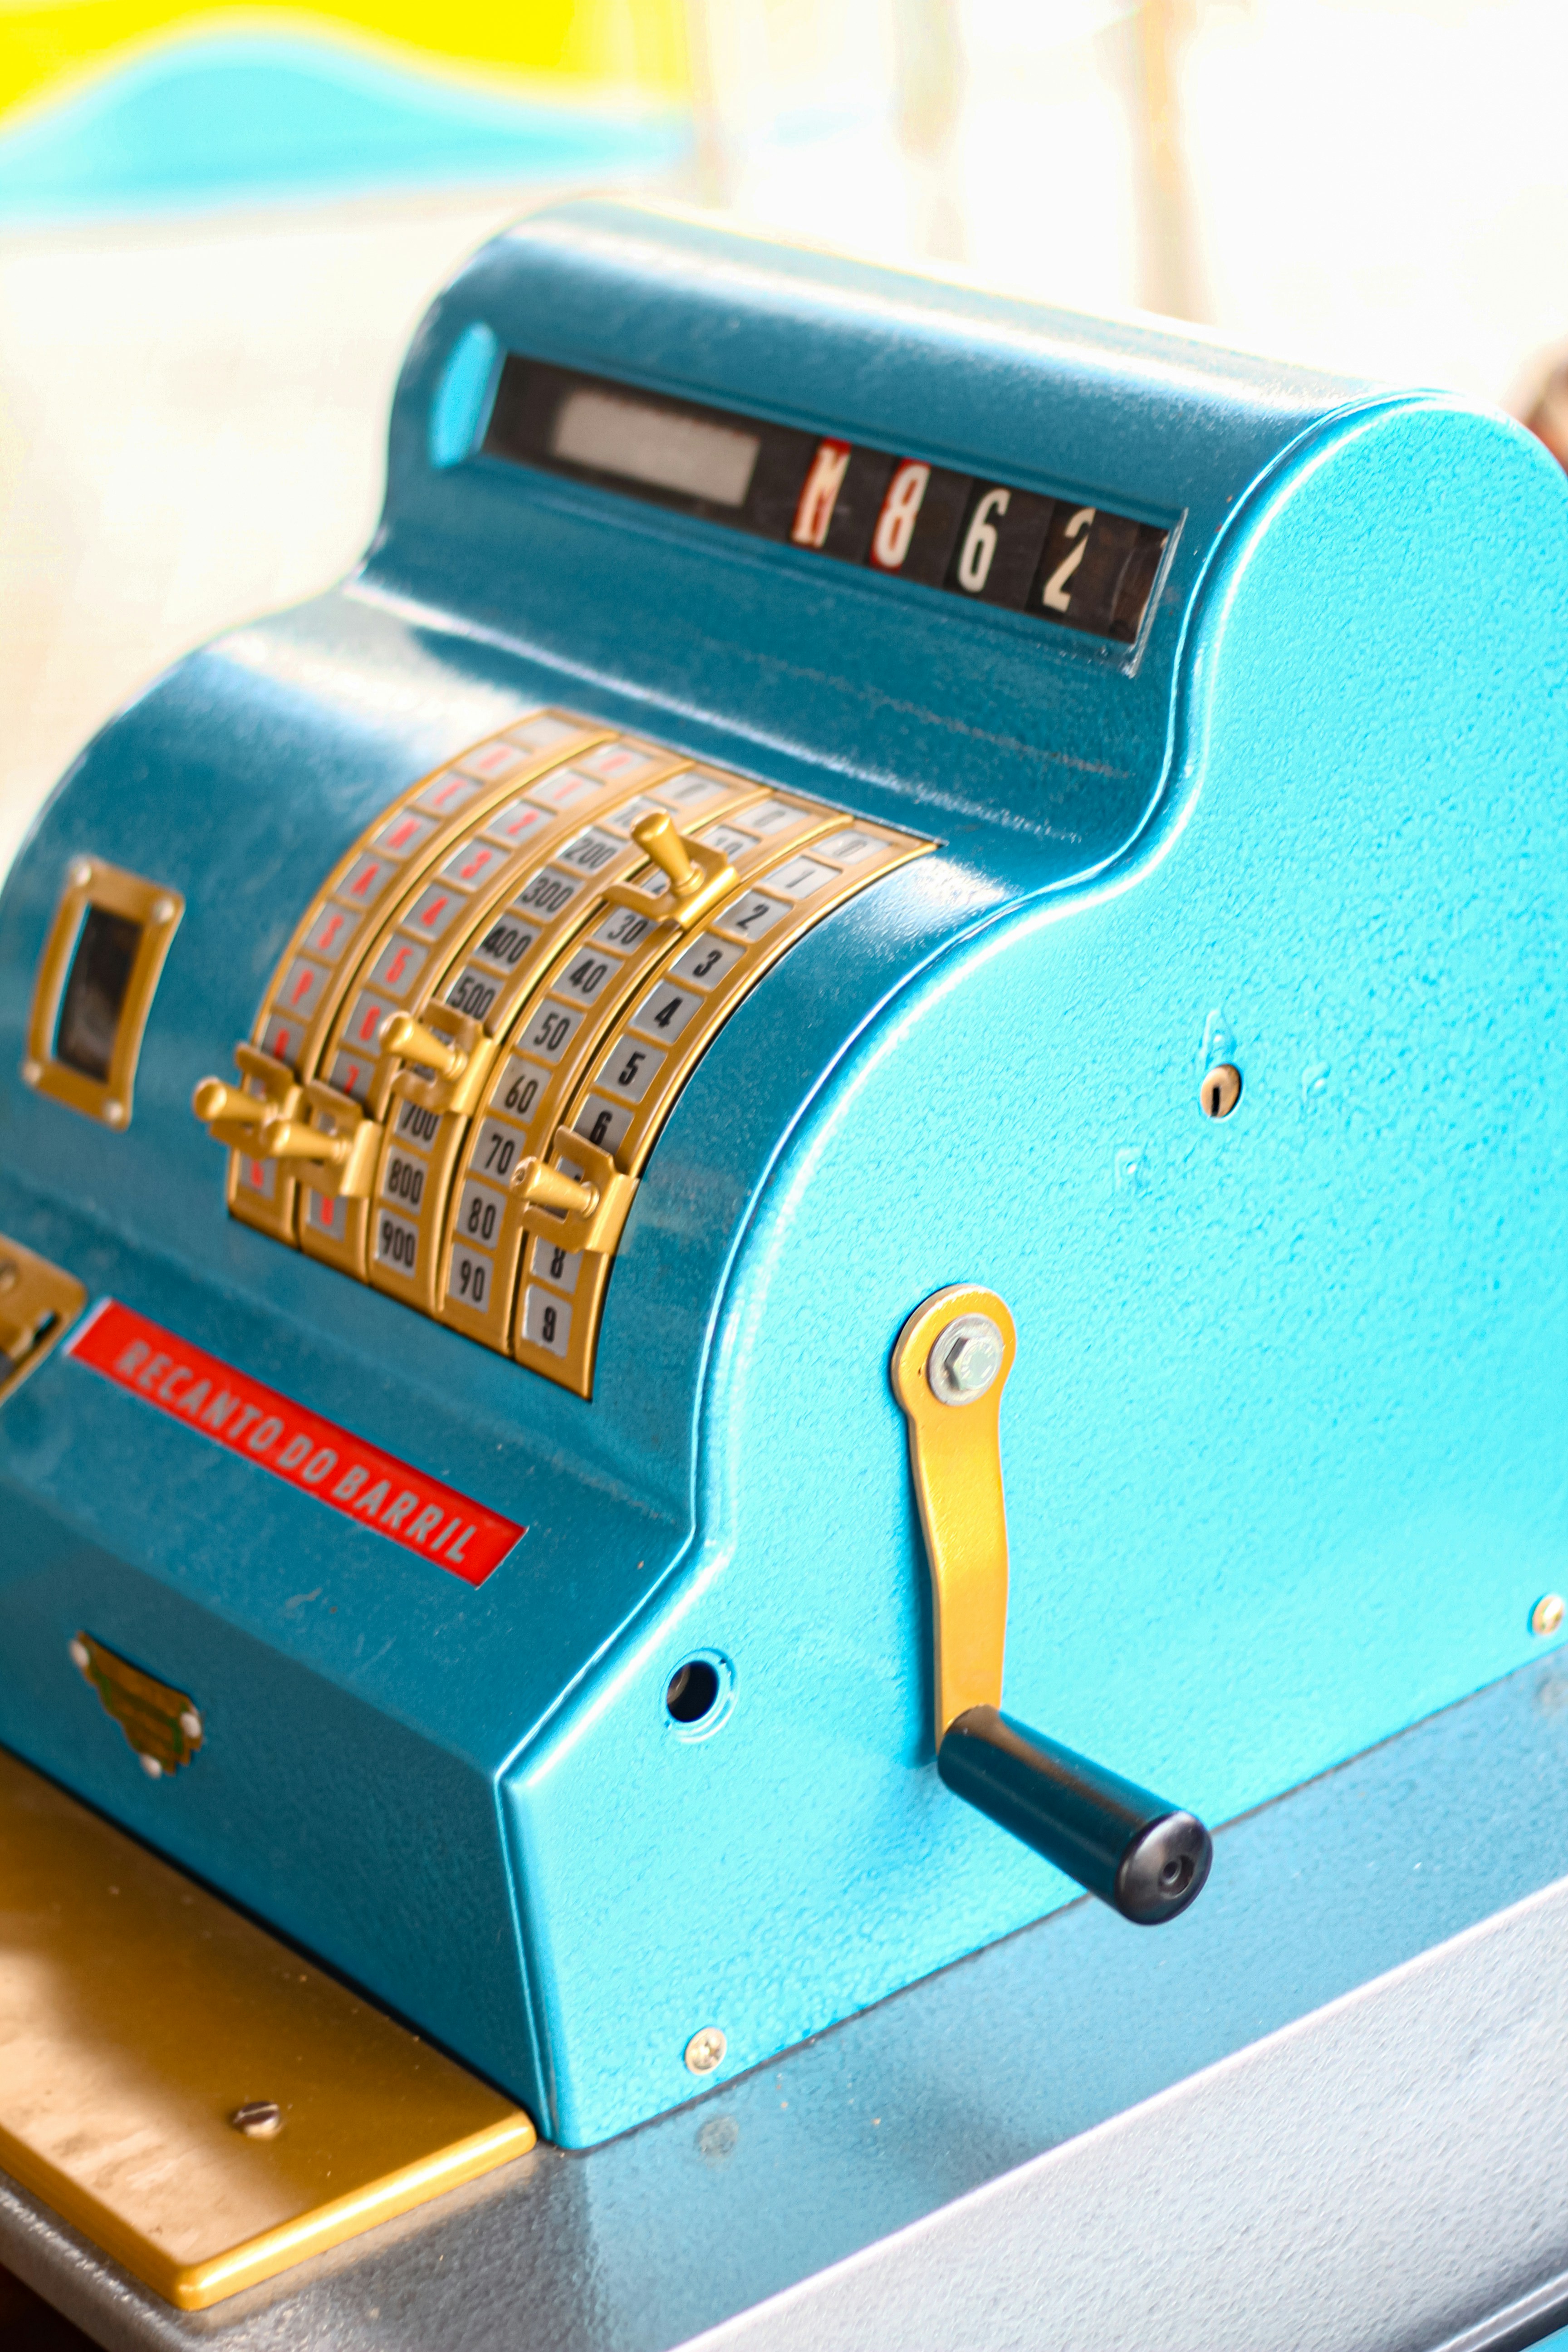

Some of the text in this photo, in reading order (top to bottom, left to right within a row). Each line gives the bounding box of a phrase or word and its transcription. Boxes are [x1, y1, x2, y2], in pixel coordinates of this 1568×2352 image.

[521, 877, 574, 913] 300
[785, 867, 816, 889] 1
[607, 914, 649, 946] 30
[735, 903, 770, 930] 2
[482, 925, 532, 965] 400
[692, 949, 723, 978] 3
[568, 958, 608, 994] 40
[451, 975, 496, 1021] 500
[654, 996, 683, 1029] 4
[533, 1009, 571, 1052] 50
[617, 1050, 647, 1087] 5
[504, 1073, 539, 1114] 60
[590, 1110, 612, 1145] 6
[485, 1132, 516, 1176] 70
[387, 1157, 424, 1205] 800
[468, 1196, 497, 1240] 80
[381, 1220, 416, 1269] 900
[460, 1259, 486, 1303] 90
[543, 1306, 558, 1343] 9
[115, 1338, 477, 1563] RECANTO DO BARRIL
